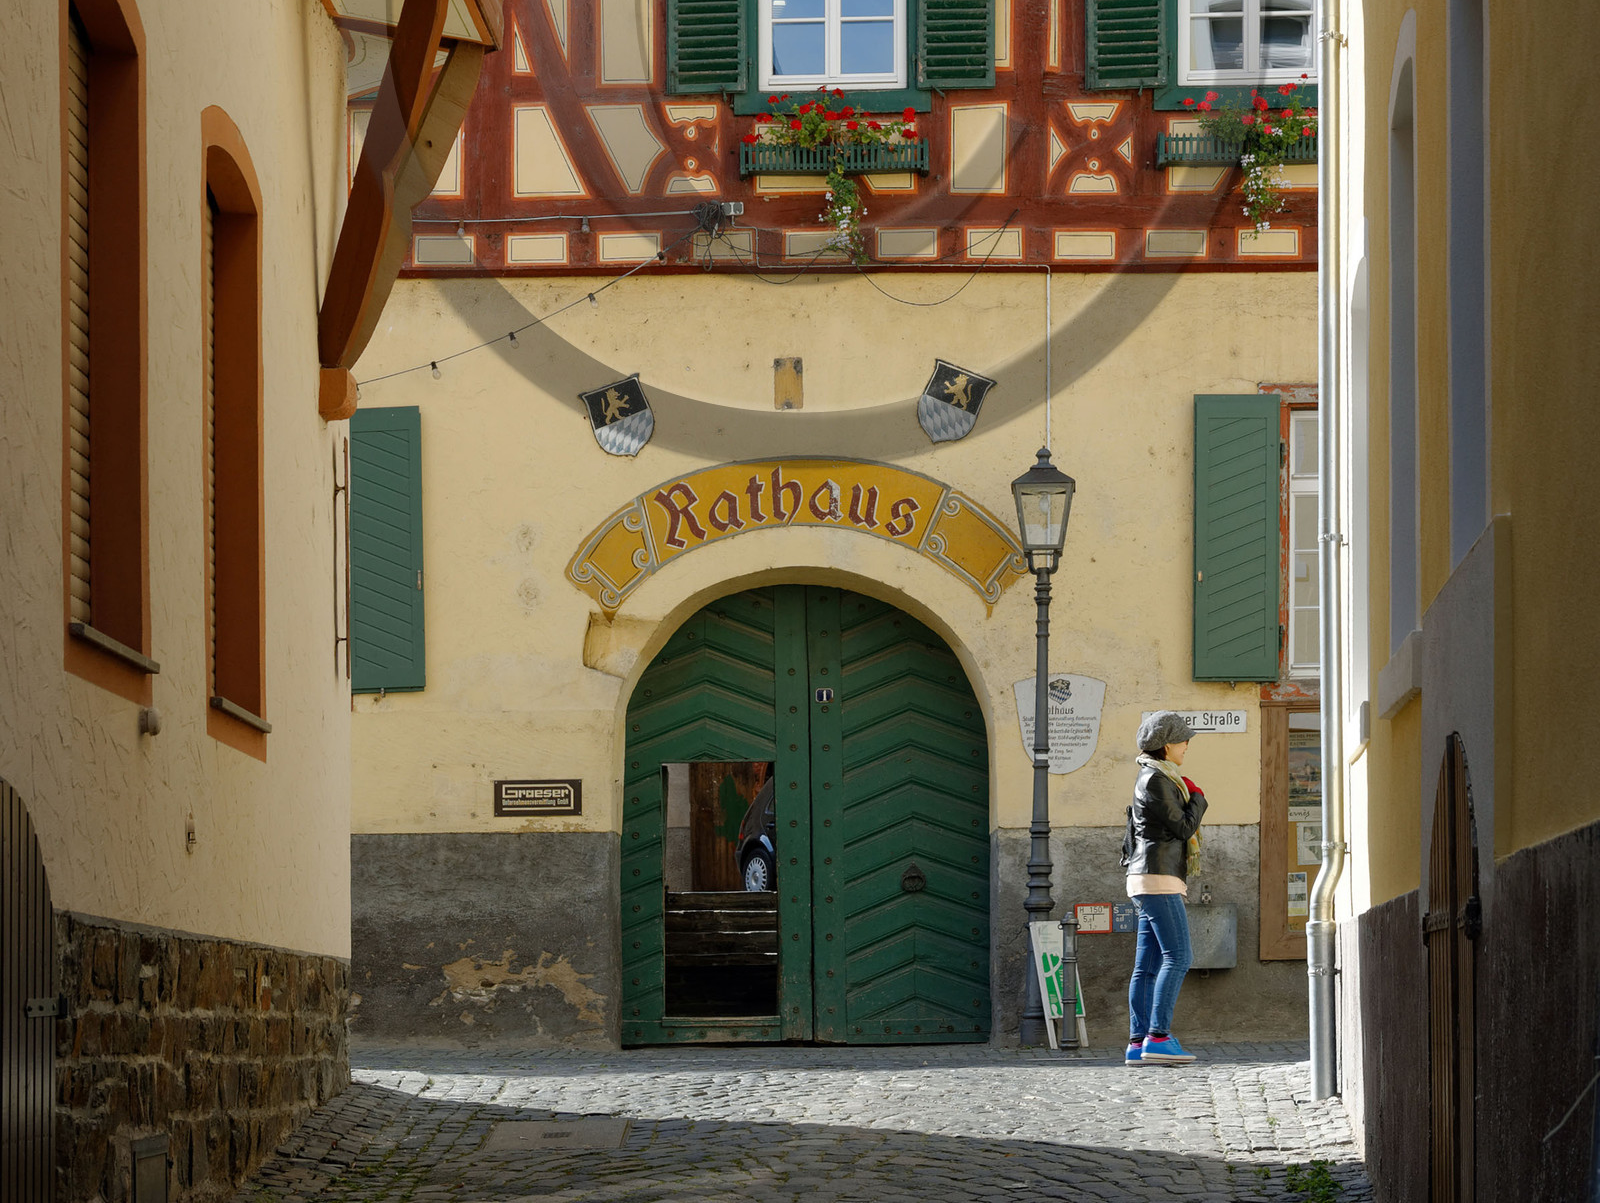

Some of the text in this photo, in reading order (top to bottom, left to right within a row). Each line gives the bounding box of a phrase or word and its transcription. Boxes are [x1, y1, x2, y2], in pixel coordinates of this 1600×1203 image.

[654, 466, 921, 549] Rathaus
[1203, 712, 1240, 725] Straße
[502, 784, 569, 799] Graeser
[1113, 906, 1120, 914] S
